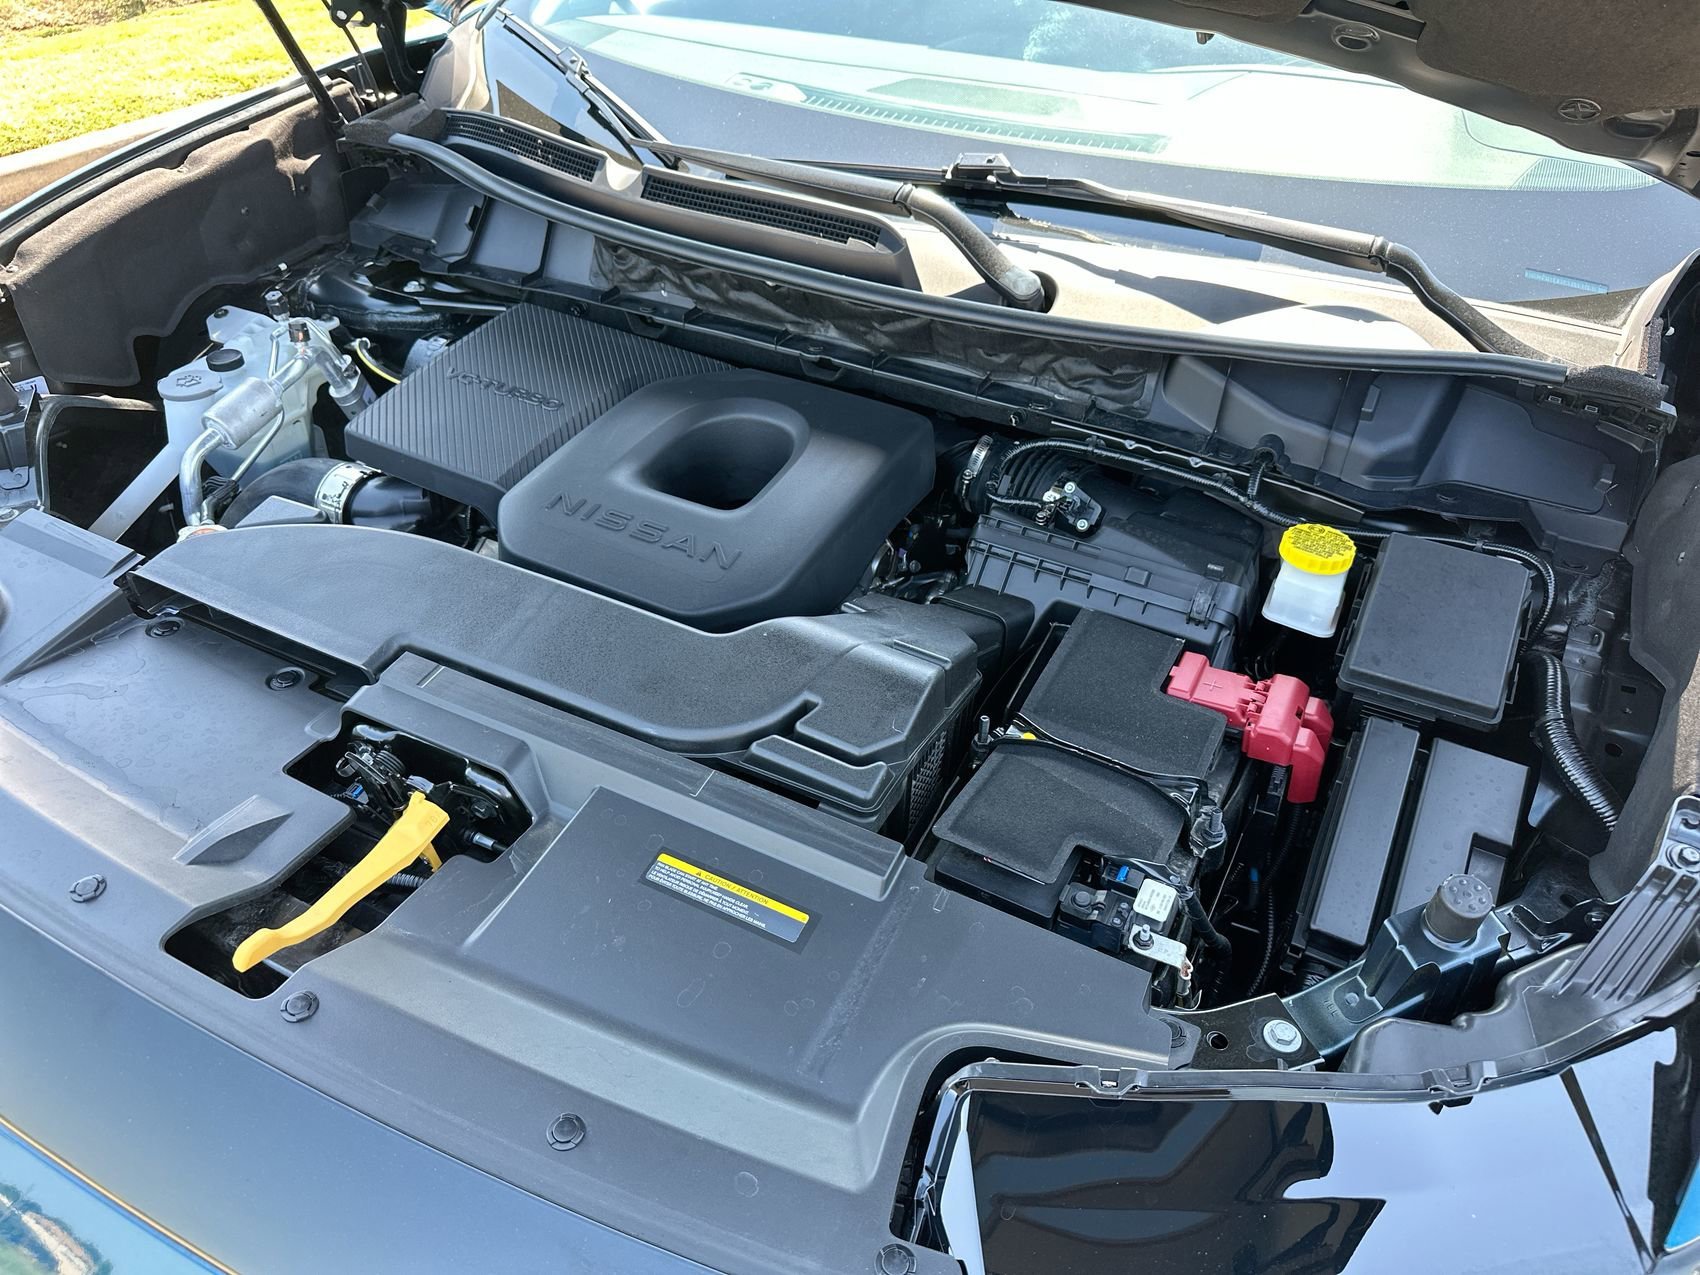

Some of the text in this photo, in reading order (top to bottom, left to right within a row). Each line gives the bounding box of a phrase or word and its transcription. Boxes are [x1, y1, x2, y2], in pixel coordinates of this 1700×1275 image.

[544, 490, 743, 570] NISSAN
[704, 874, 731, 888] CAUTION
[736, 888, 769, 904] ATTENTION
